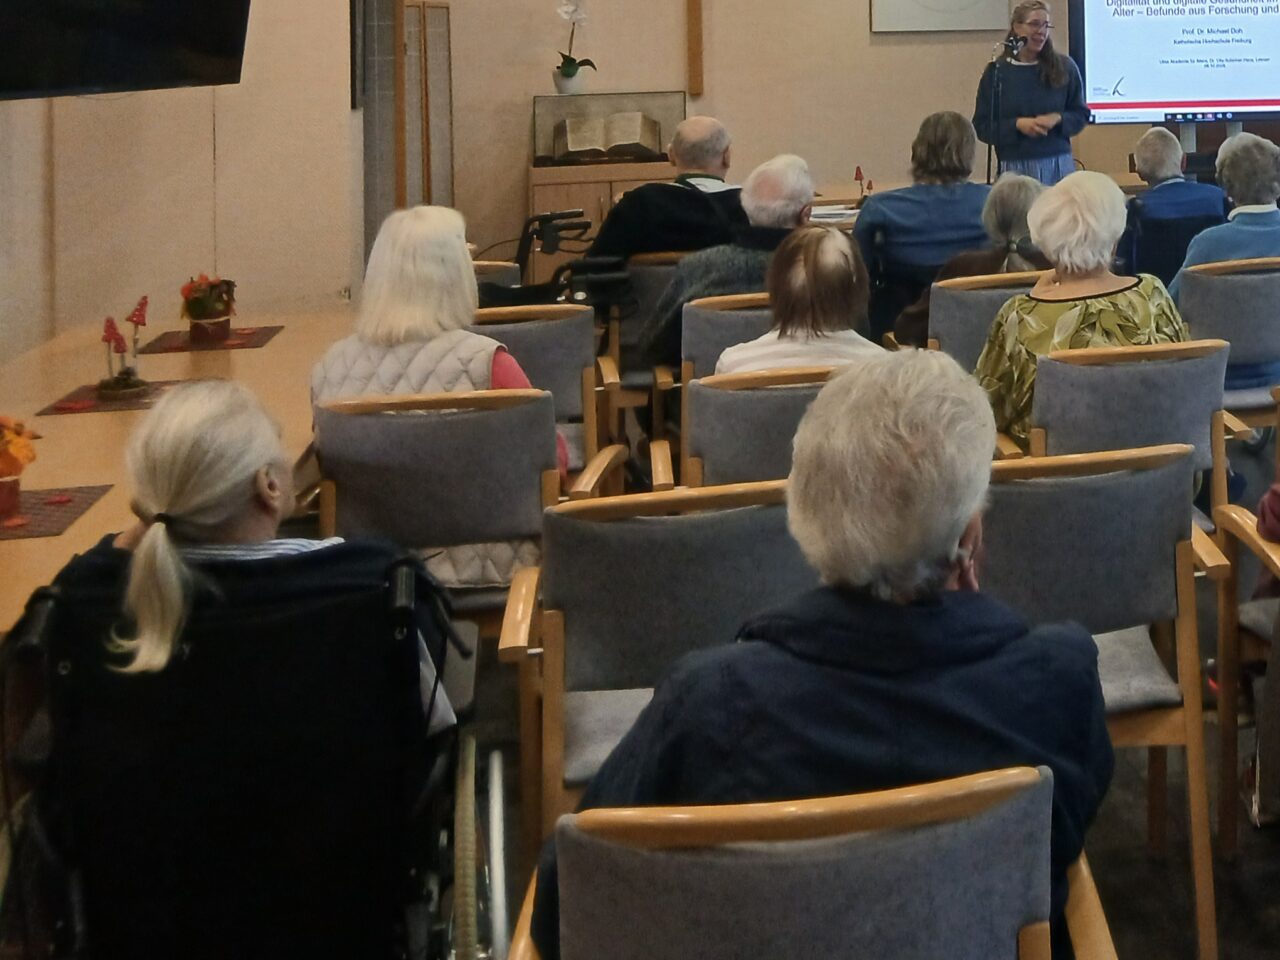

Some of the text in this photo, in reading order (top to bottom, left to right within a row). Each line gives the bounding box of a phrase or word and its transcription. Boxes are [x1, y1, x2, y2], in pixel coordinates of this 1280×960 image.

[1146, 6, 1186, 16] Befunde
[1208, 5, 1259, 16] Forschung
[1261, 3, 1280, 14] und
